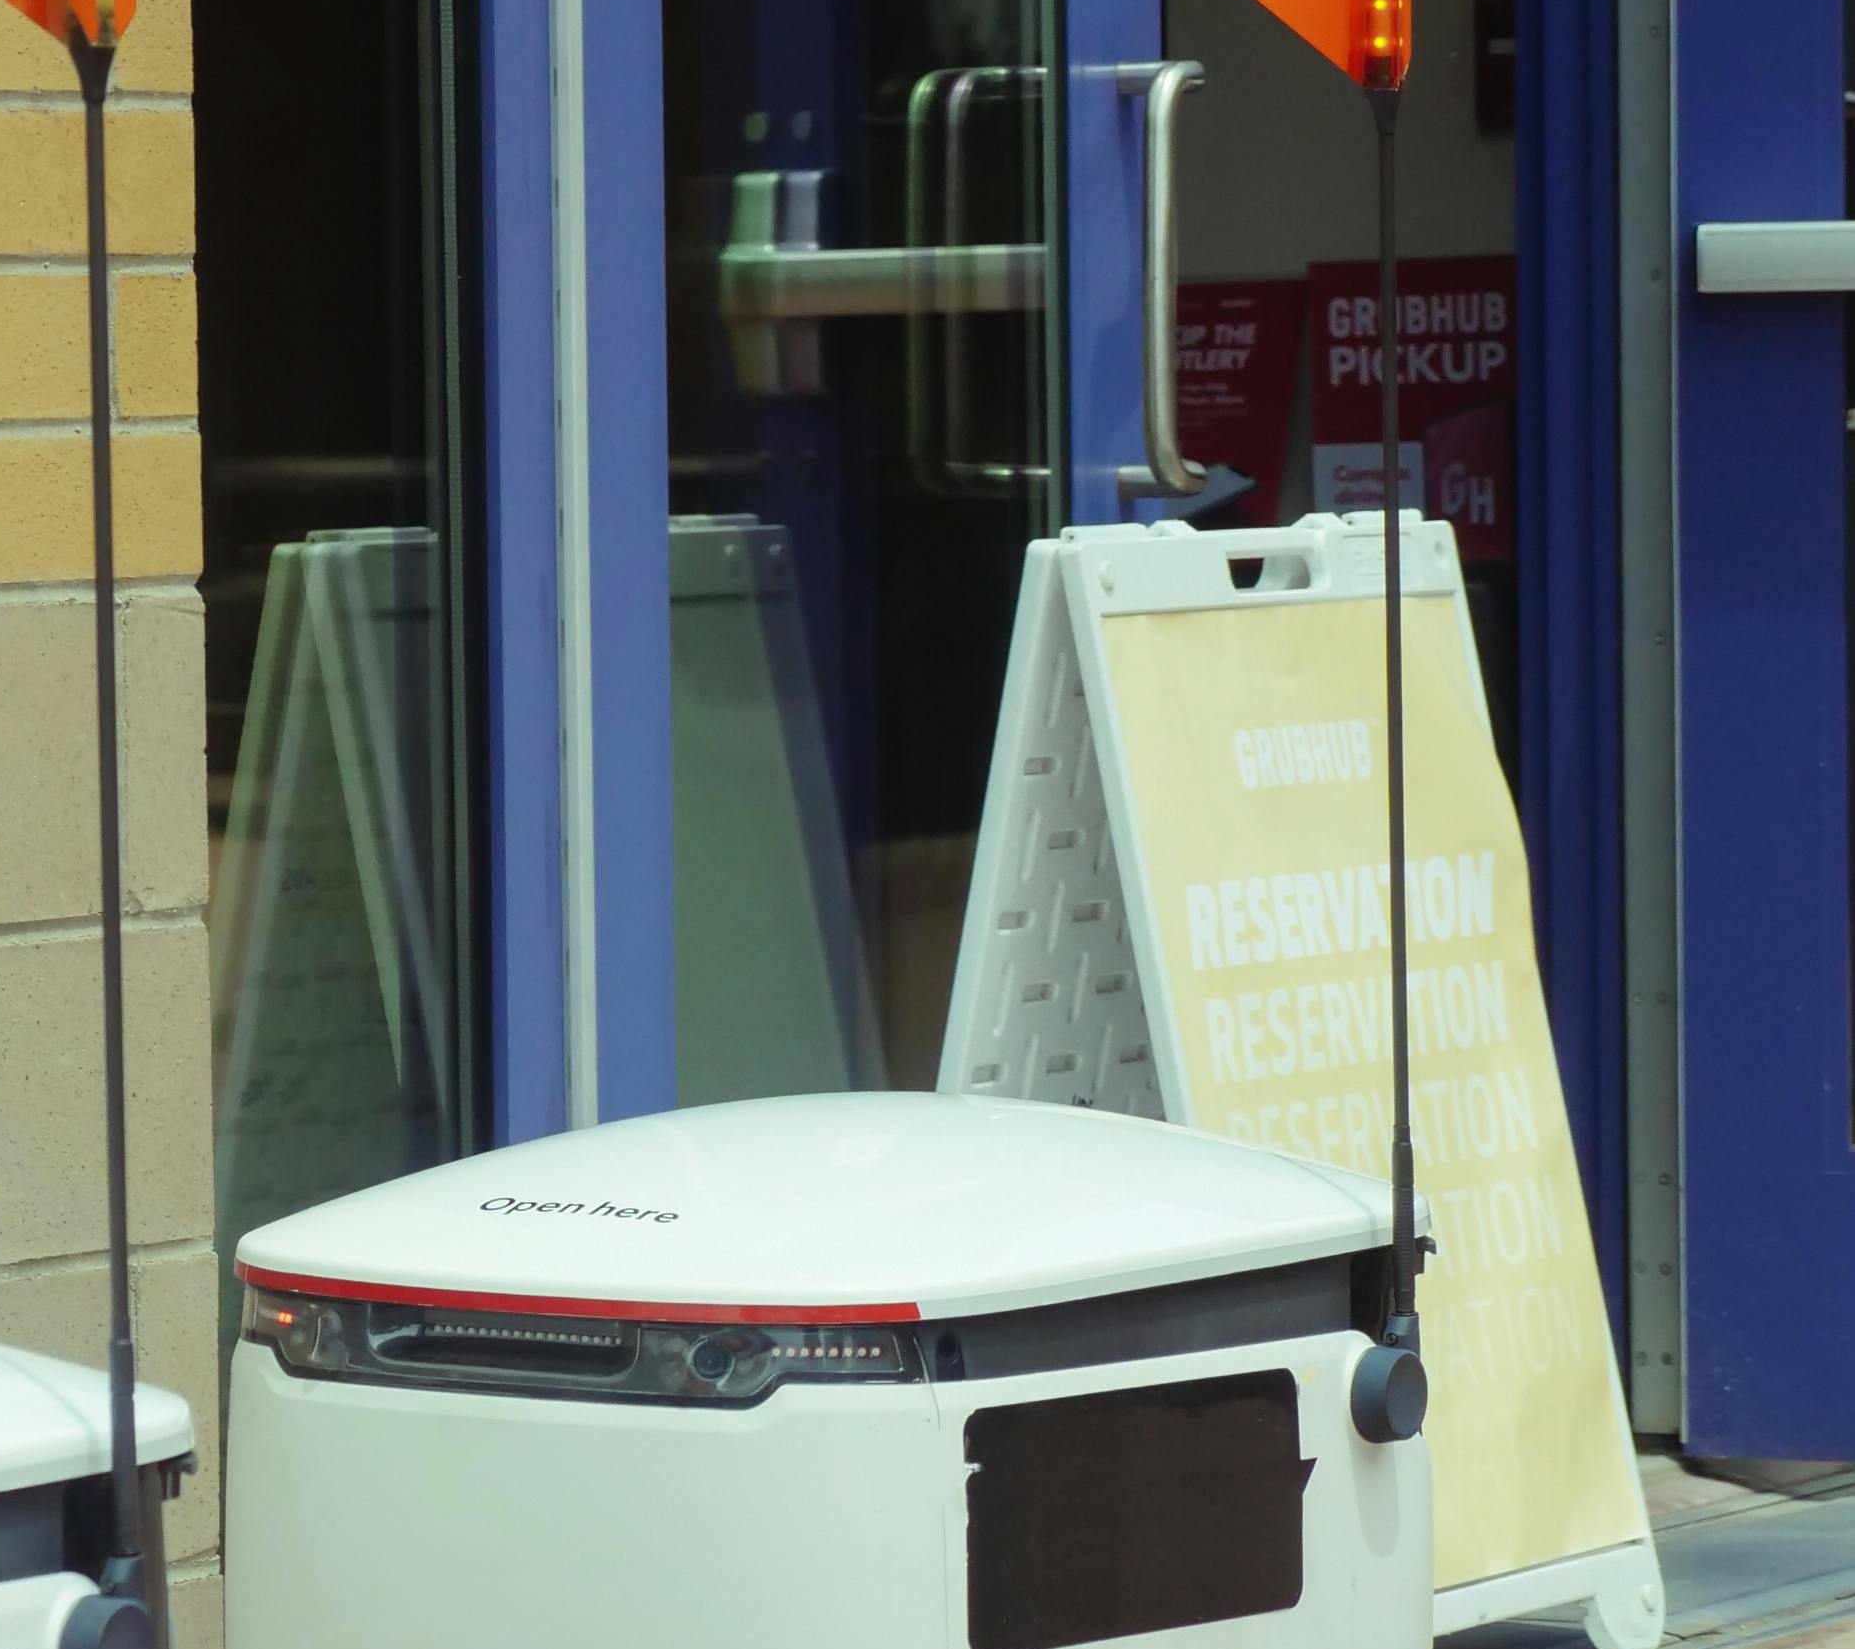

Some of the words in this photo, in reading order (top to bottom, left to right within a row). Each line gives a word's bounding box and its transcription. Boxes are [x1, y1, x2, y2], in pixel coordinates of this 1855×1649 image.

[1327, 291, 1508, 337] GRBHUB
[1233, 719, 1373, 791] GRUBHUB
[479, 1196, 586, 1216] Open
[588, 1200, 680, 1224] here
